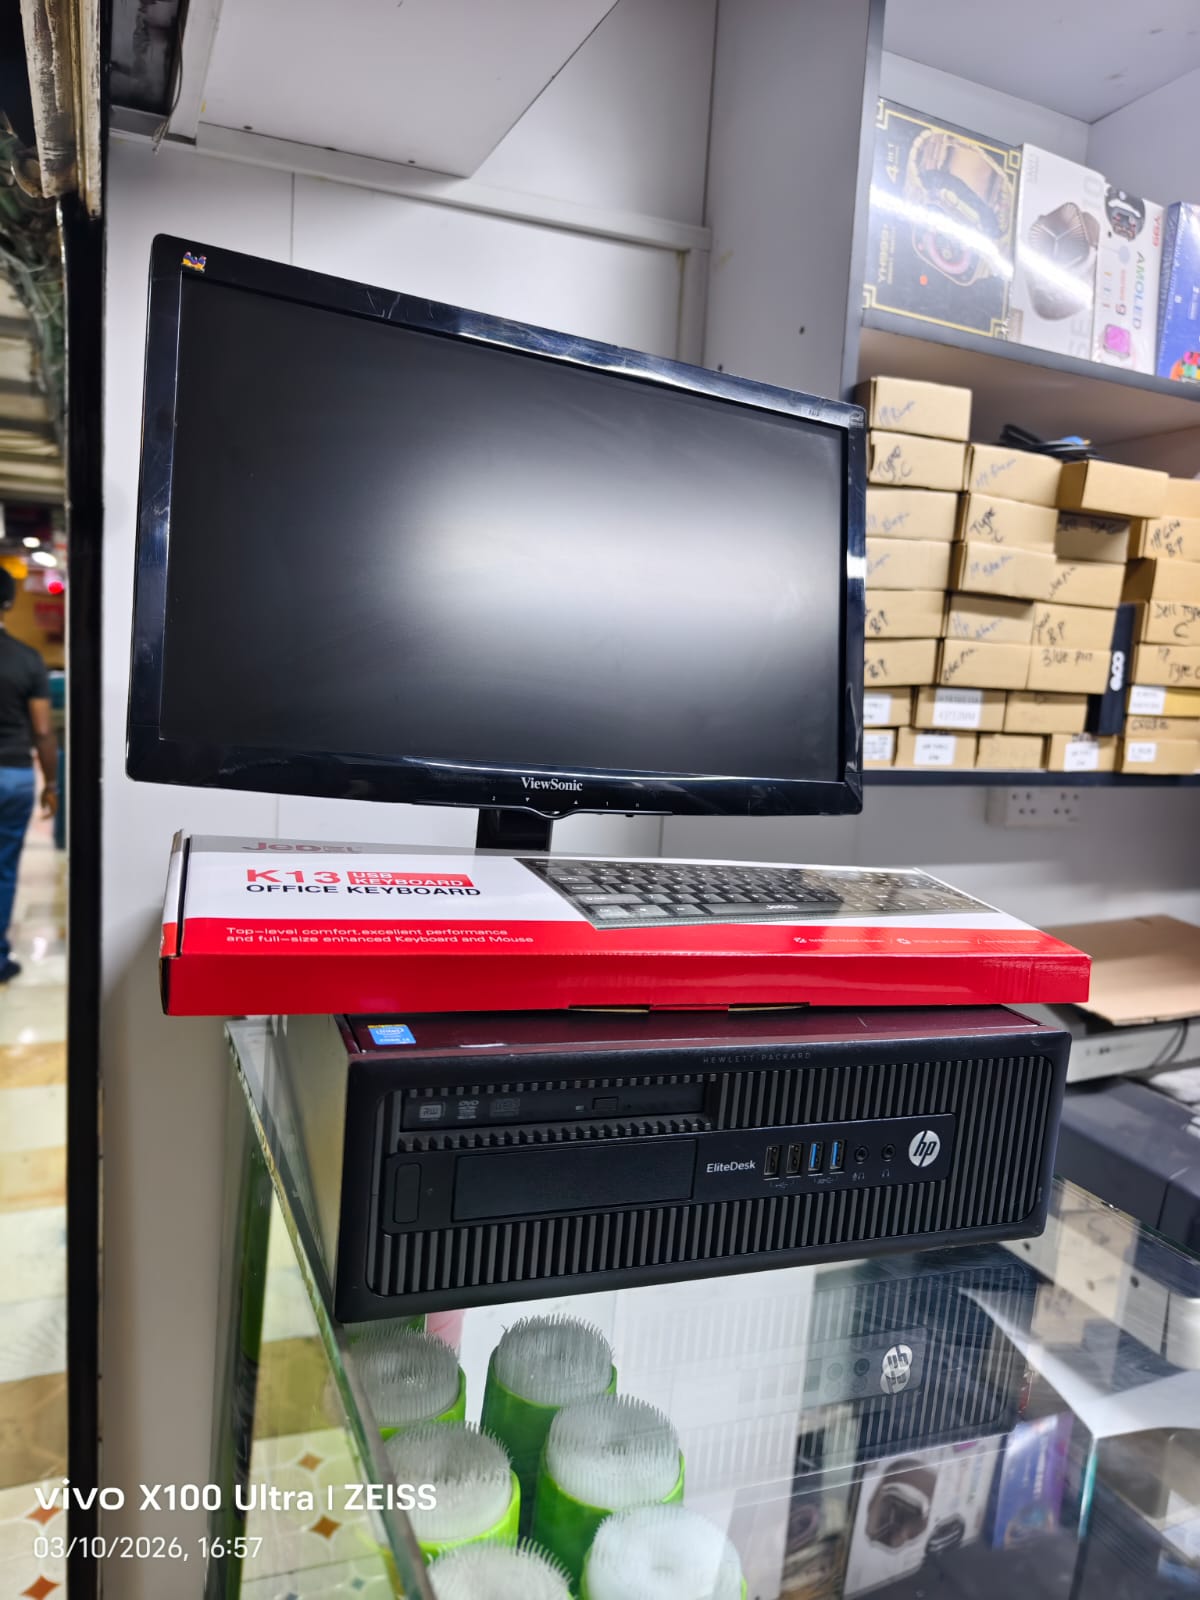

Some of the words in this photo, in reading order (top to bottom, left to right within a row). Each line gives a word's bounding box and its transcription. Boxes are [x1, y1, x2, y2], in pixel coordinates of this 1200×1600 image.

[1132, 250, 1145, 330] AMOLED
[1172, 621, 1190, 639] C
[521, 776, 583, 792] ViewSonic
[246, 869, 341, 884] K13
[353, 871, 393, 879] USB
[355, 878, 463, 887] KEYBOARD
[246, 884, 339, 893] OFFICE
[347, 886, 481, 896] KEYBOARD
[226, 935, 254, 943] and
[323, 935, 392, 943] enhanced
[395, 935, 459, 944] Keyboard
[461, 935, 487, 943] and
[489, 935, 535, 943] Mouse
[425, 928, 508, 937] performance
[909, 1129, 941, 1168] hp
[706, 1159, 756, 1173] EliteDesk
